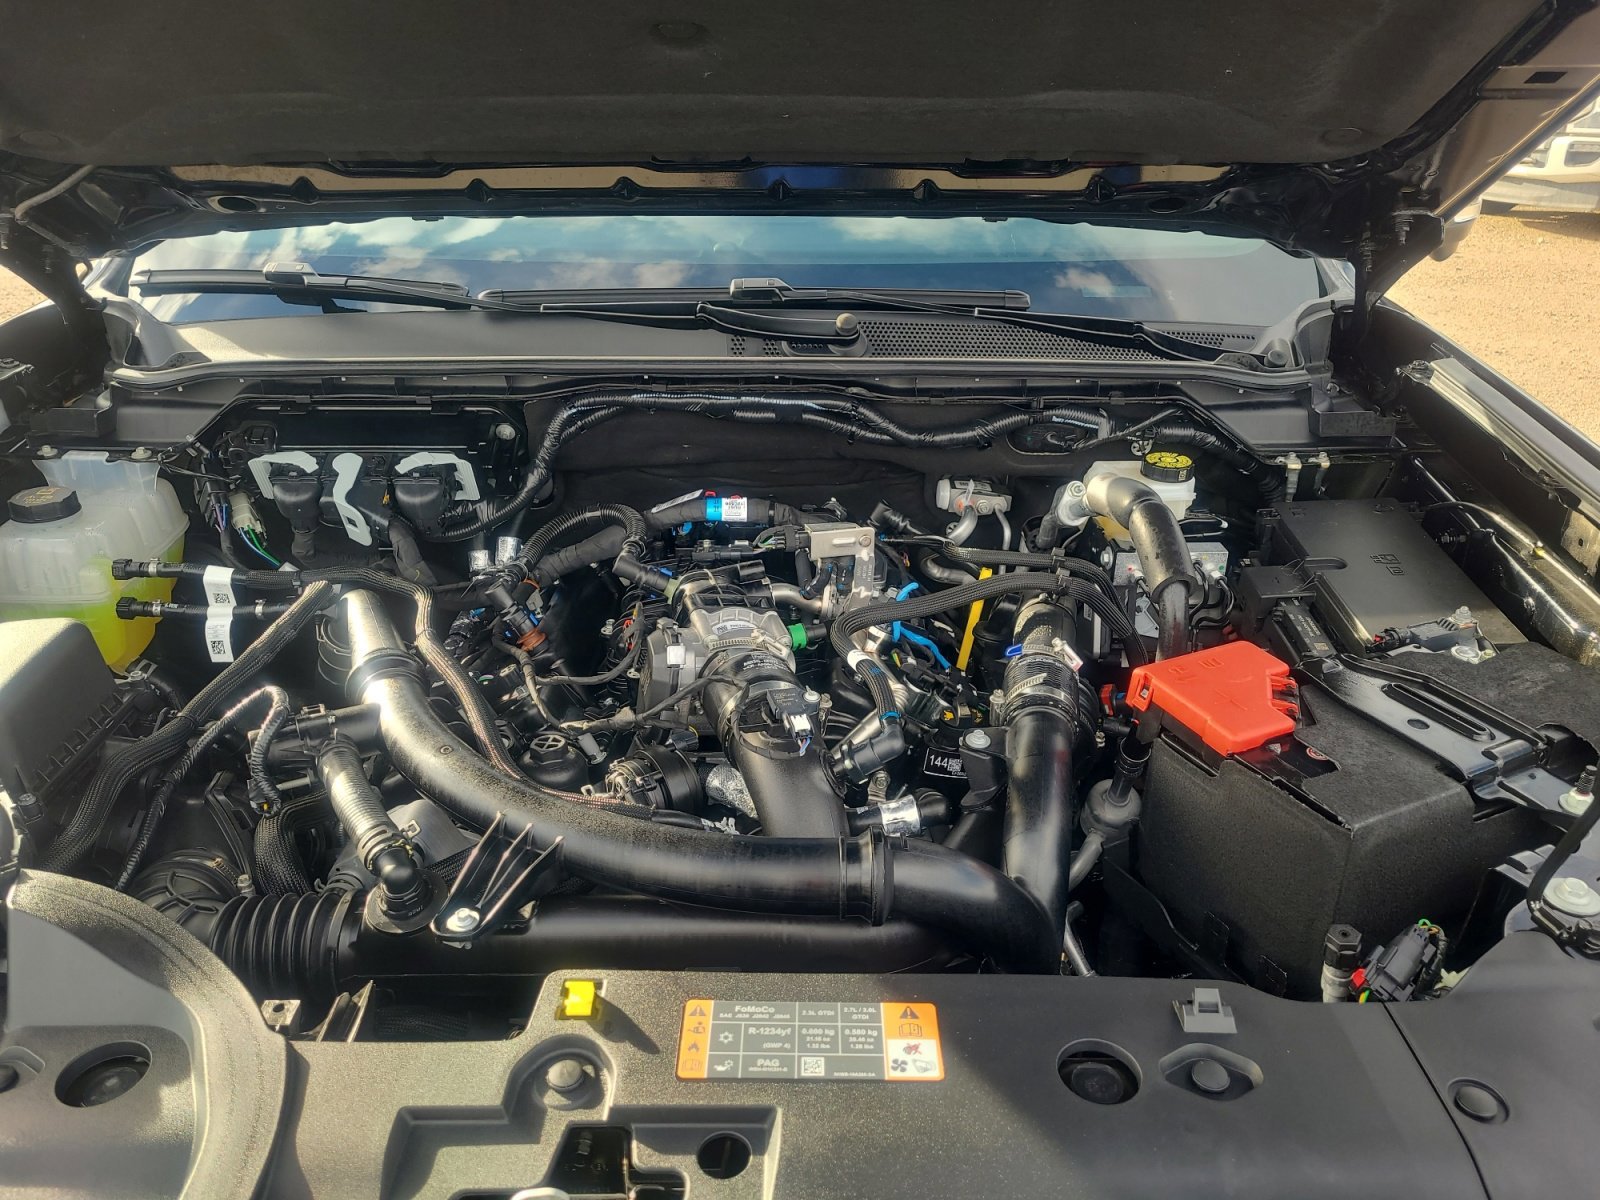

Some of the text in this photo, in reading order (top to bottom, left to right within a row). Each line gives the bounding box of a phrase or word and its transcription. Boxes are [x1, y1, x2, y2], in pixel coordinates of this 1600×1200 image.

[930, 754, 948, 769] 144
[735, 1005, 776, 1013] FoMoCo
[748, 1027, 792, 1037] R-1234yf
[867, 1029, 878, 1037] kg
[757, 1059, 780, 1067] PAG
